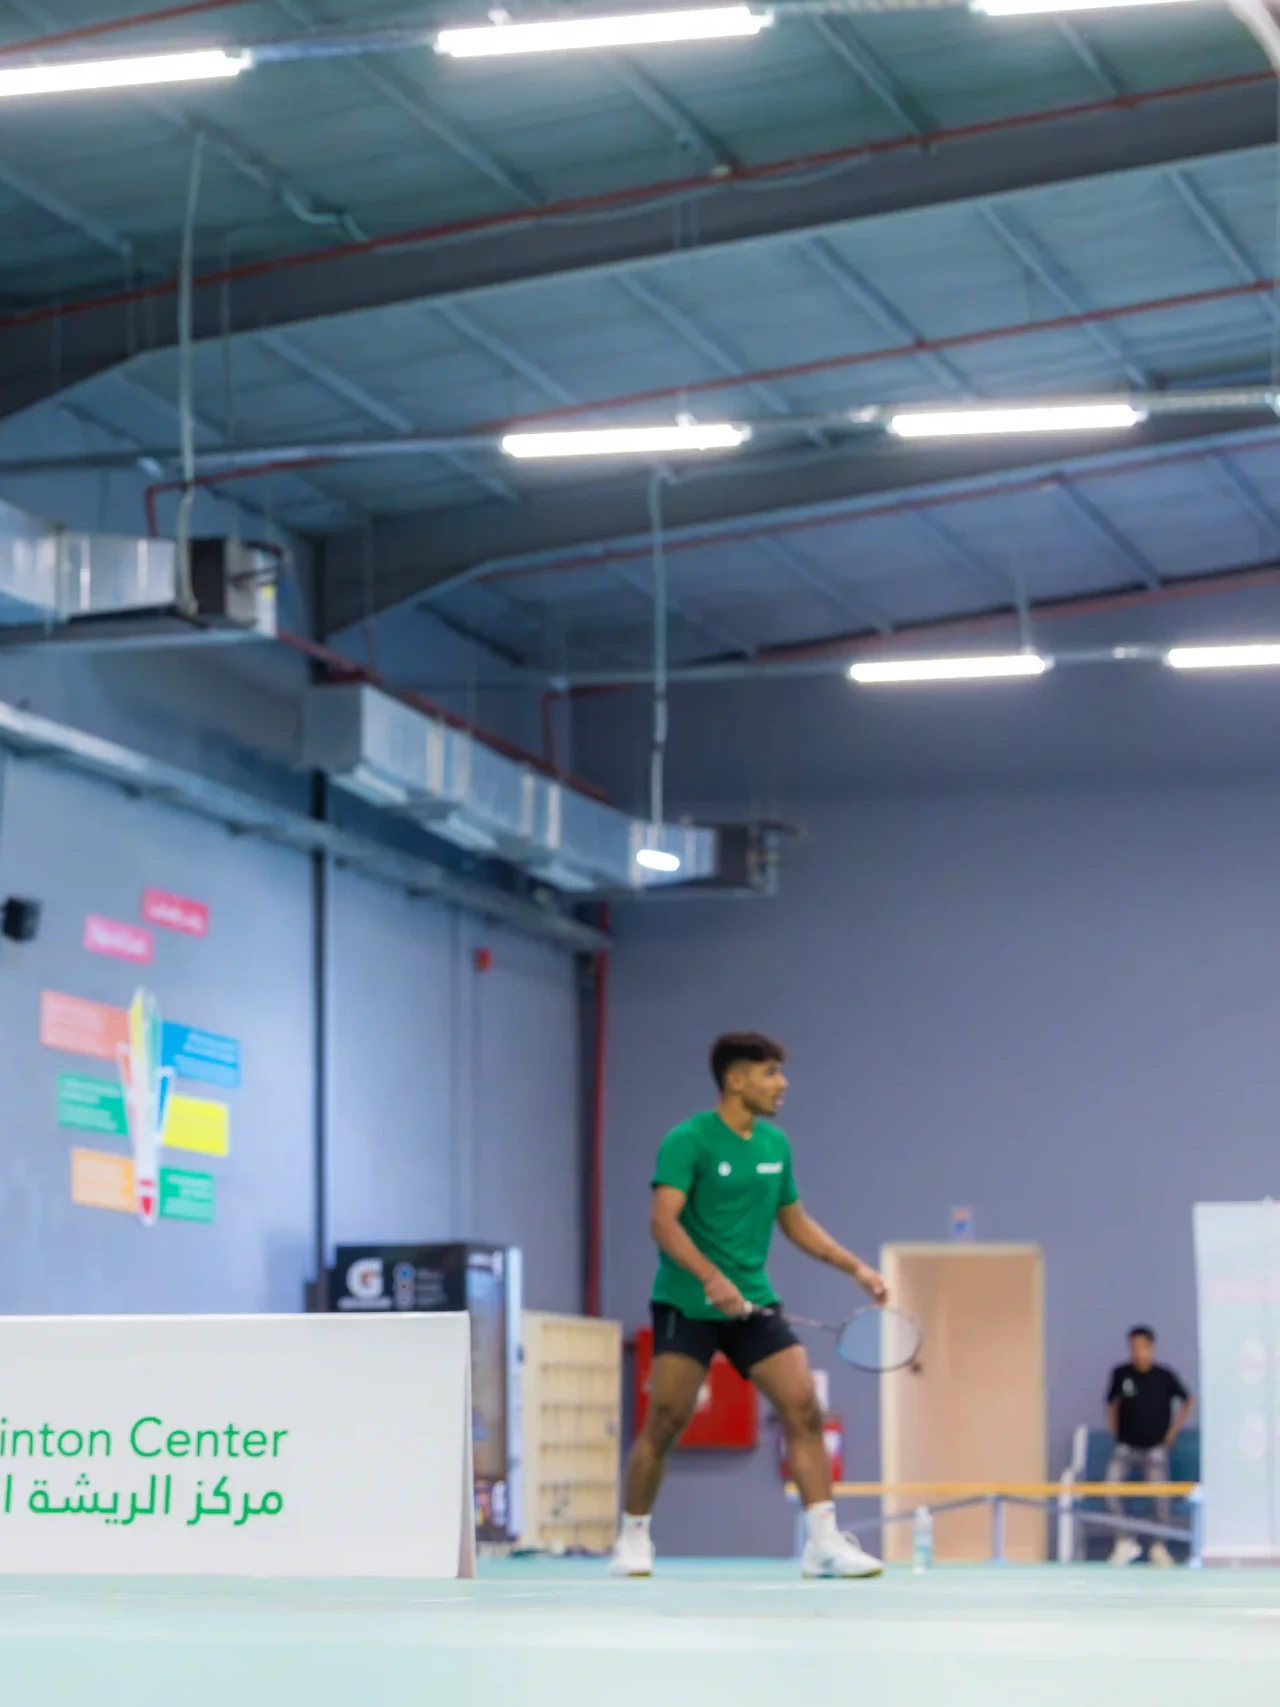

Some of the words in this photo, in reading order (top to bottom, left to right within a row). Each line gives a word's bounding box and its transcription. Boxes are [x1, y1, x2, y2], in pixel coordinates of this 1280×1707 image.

[129, 1415, 289, 1459] Center
[27, 1472, 172, 1526] الريشة
[186, 1474, 284, 1527] مركز
